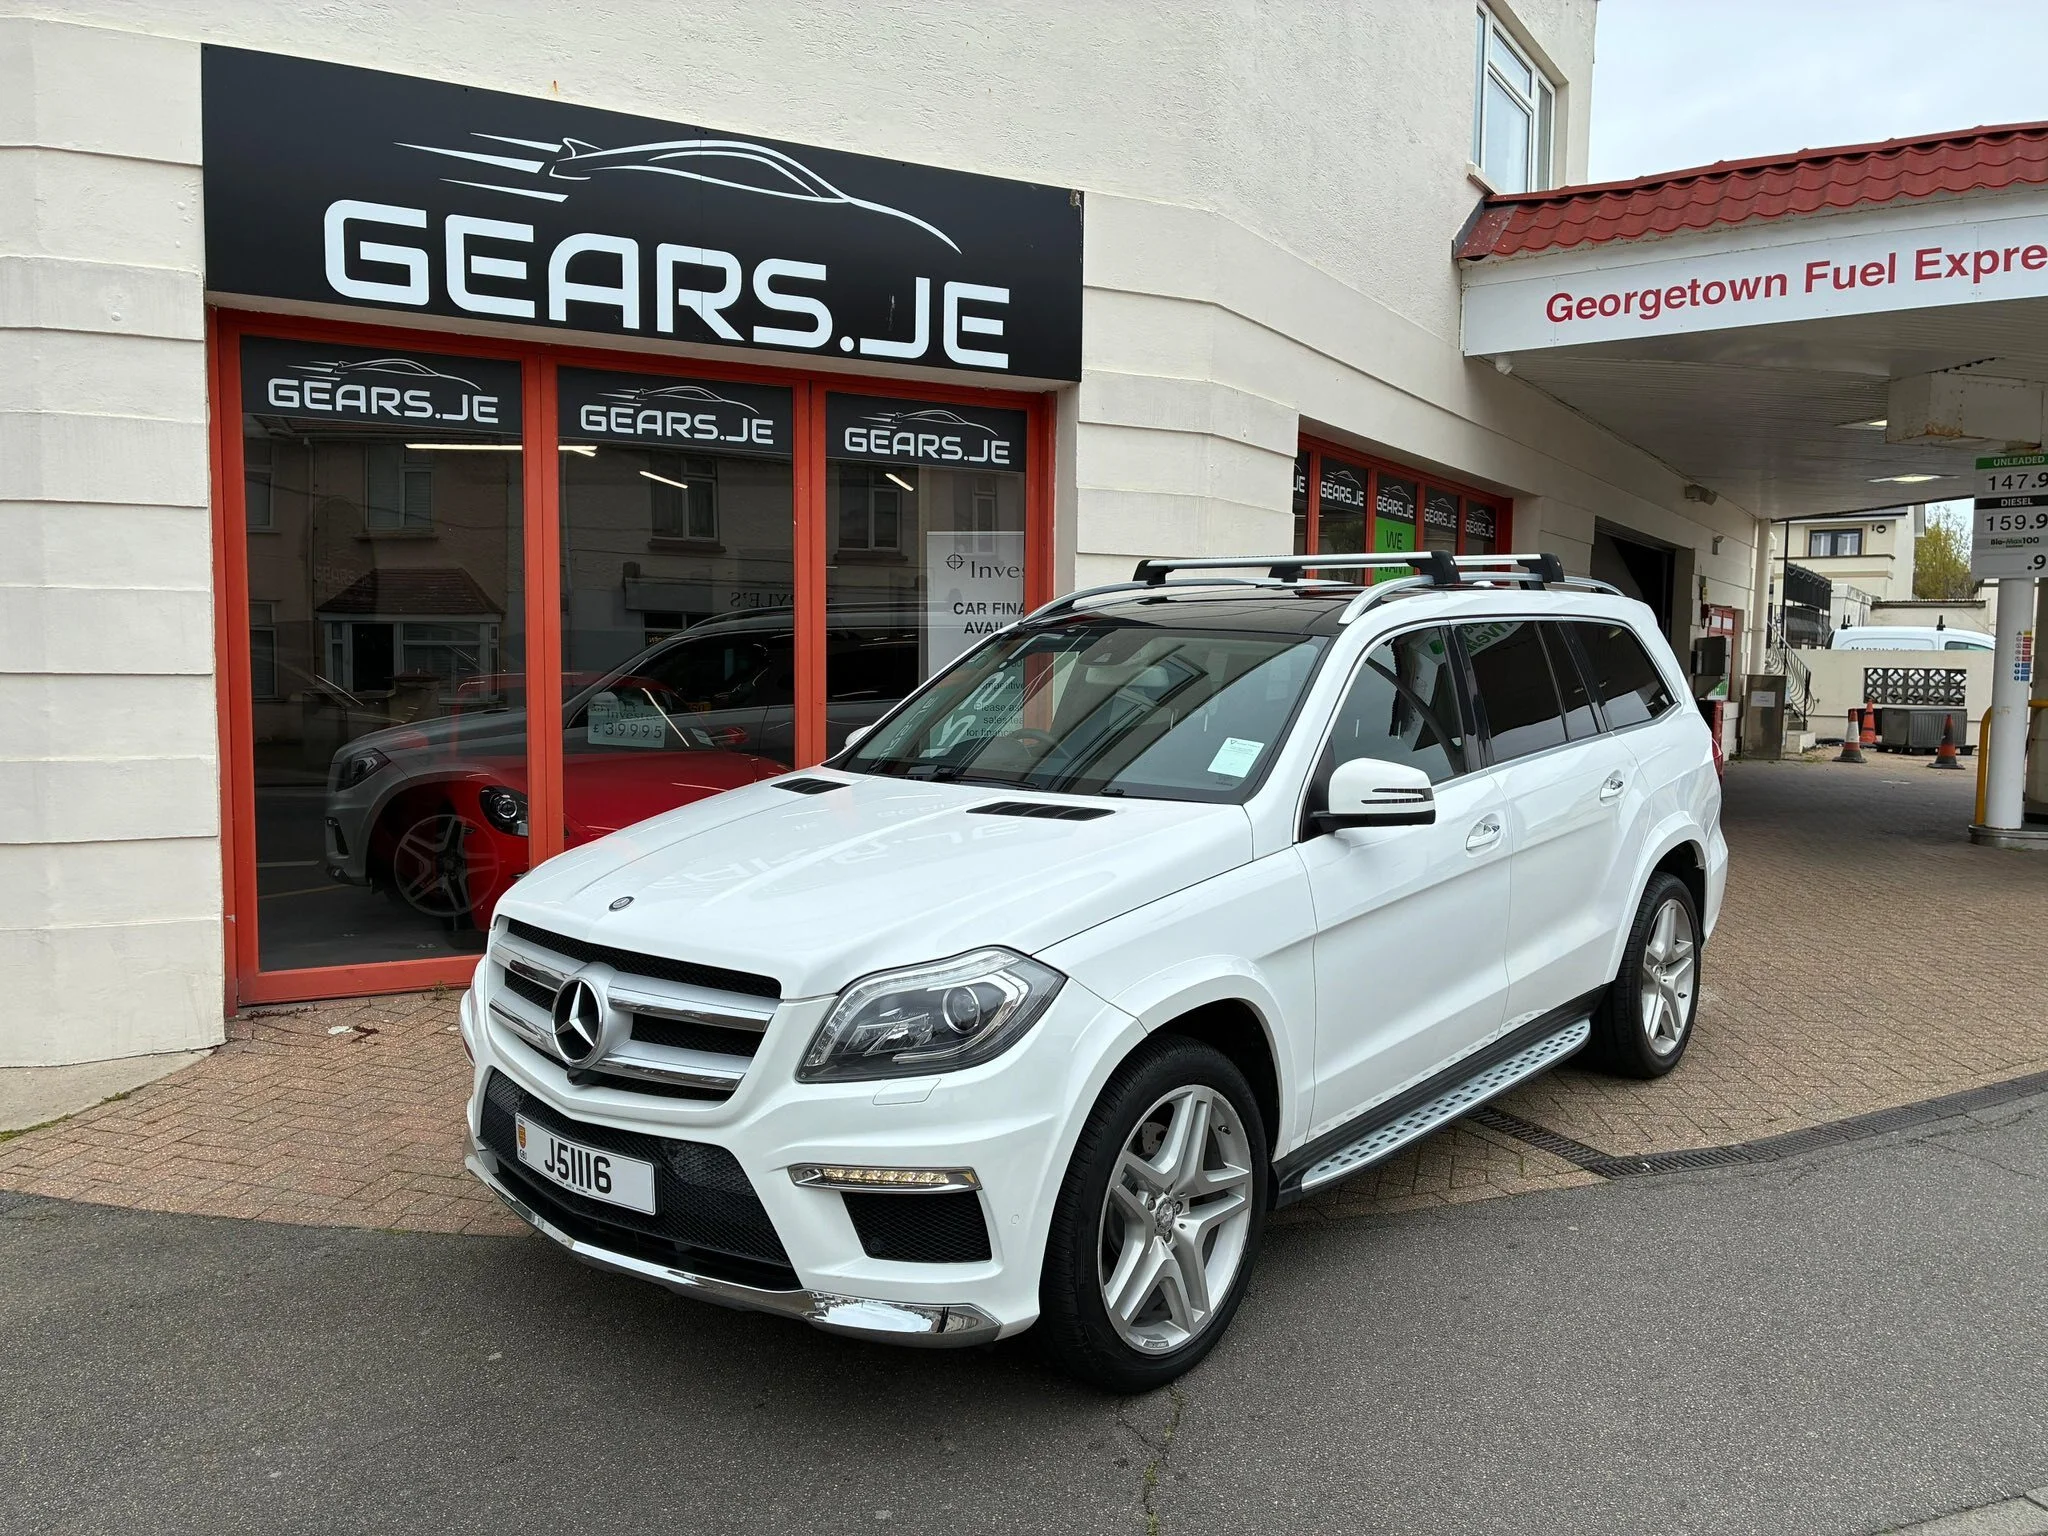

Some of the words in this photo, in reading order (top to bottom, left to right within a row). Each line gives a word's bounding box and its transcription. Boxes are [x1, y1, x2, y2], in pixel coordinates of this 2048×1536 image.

[324, 199, 1010, 369] GEARS.JE
[1545, 272, 1787, 324] Georgetown
[1804, 252, 1897, 294] Fuel
[1914, 243, 2048, 284] Expre
[267, 376, 499, 424] GEARS.JE
[580, 404, 775, 446] GEARS.JE
[844, 427, 1011, 465] GEARS.JE
[1993, 455, 2045, 467] UNLEADED
[1988, 472, 2048, 491] 147.9
[1320, 481, 1365, 507] GEARS.JE
[2000, 497, 2033, 507] DIESEL
[1376, 495, 1414, 519] GEARS.JE
[1424, 507, 1457, 529] GEARS.JE
[1465, 519, 1495, 538] GEARS.JE
[1986, 513, 2048, 532] 159.9
[1385, 529, 1403, 550] WE
[970, 560, 1024, 579] Inve
[953, 601, 987, 615] CAR
[605, 722, 662, 739] 39995
[544, 1137, 612, 1194] J51116
